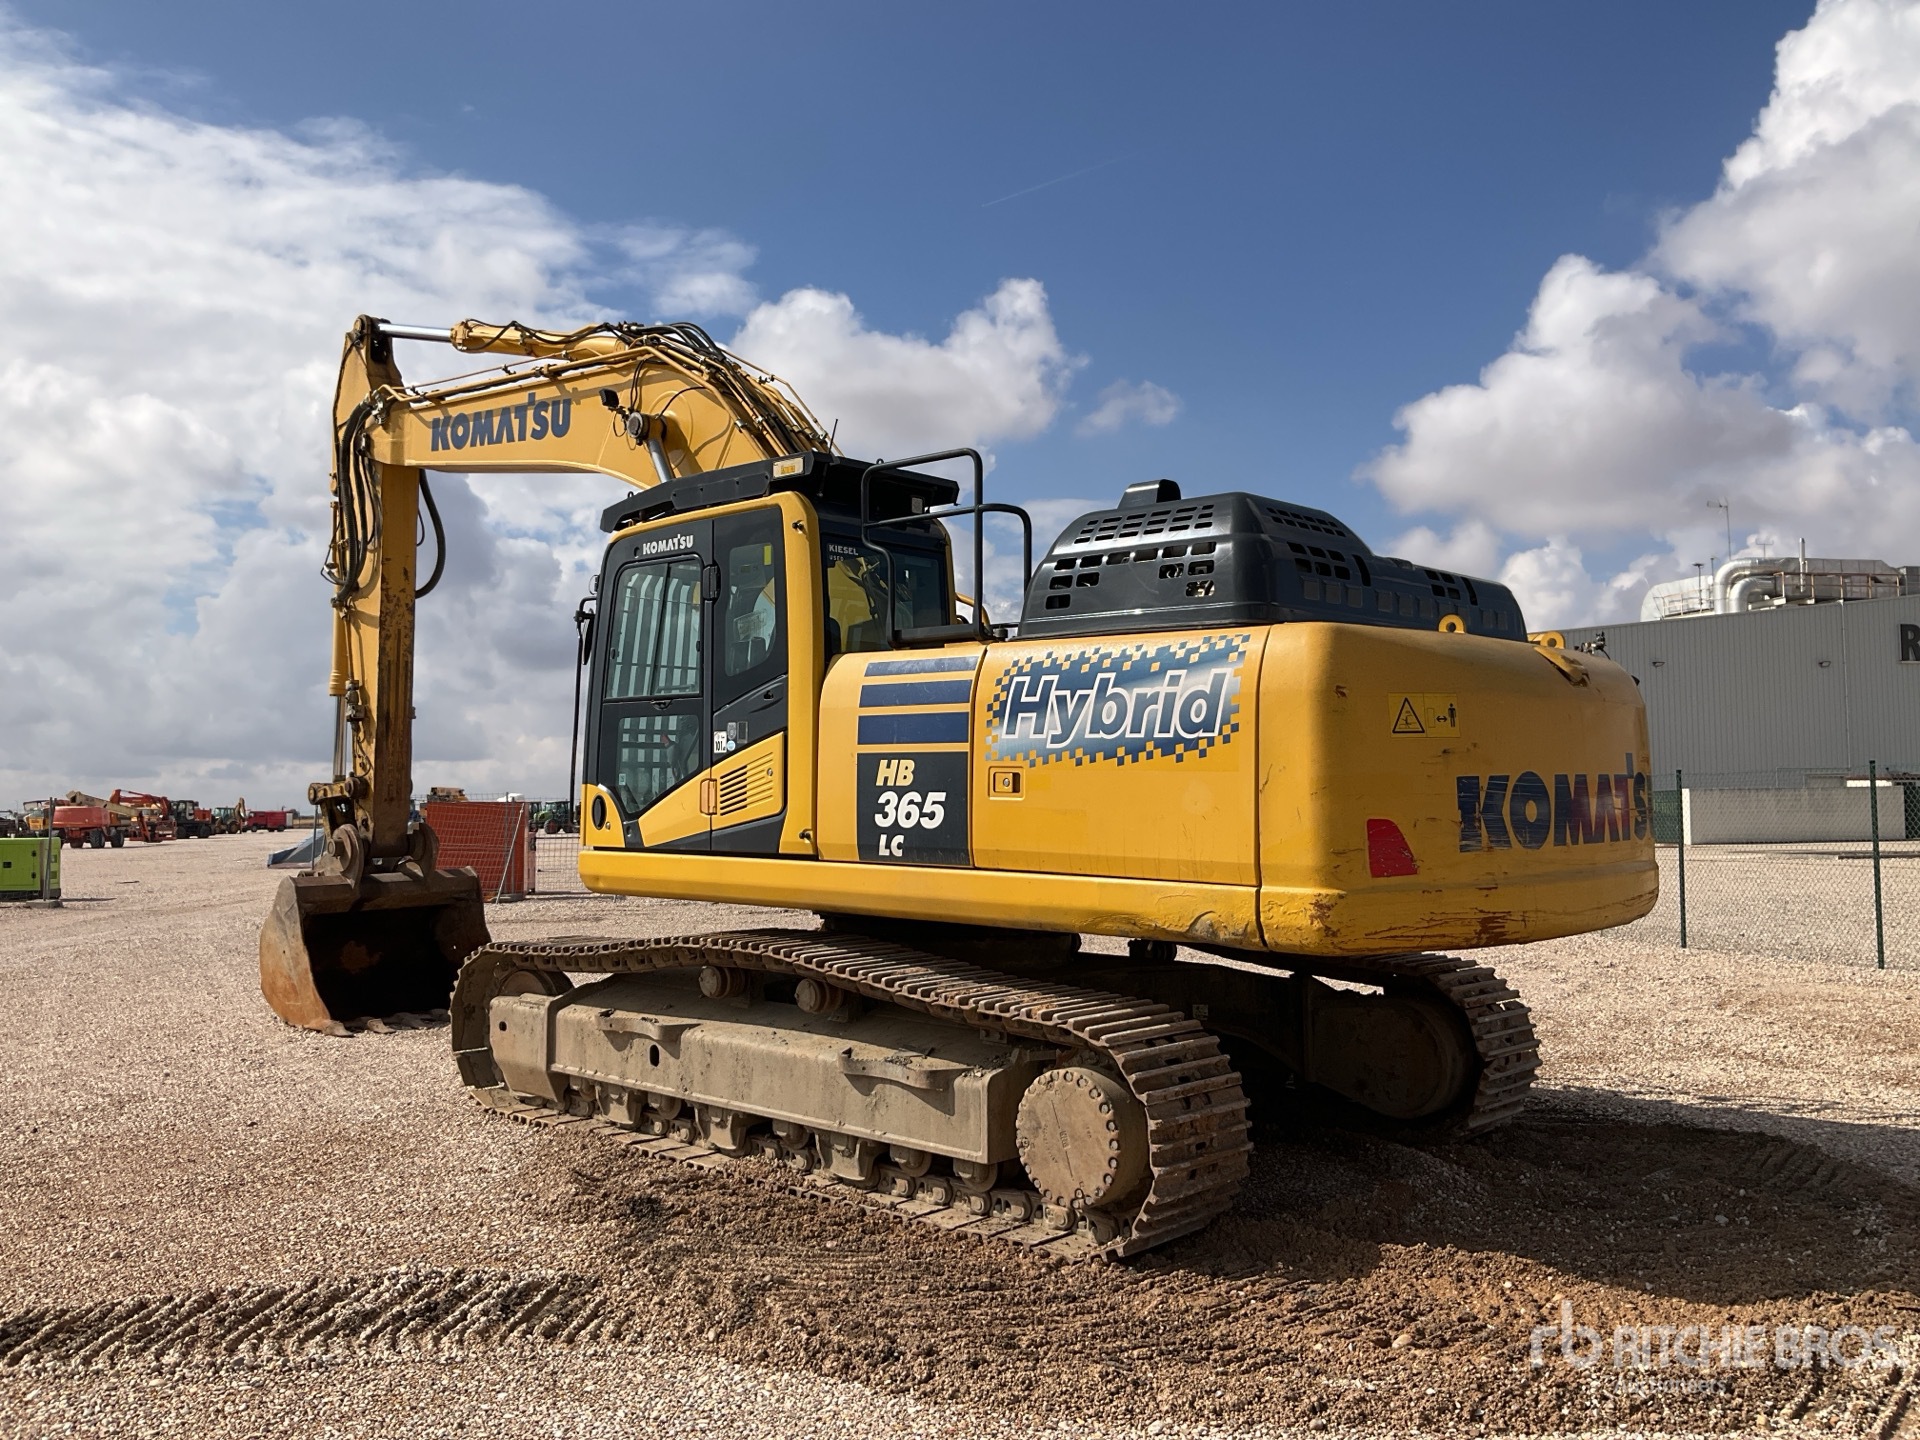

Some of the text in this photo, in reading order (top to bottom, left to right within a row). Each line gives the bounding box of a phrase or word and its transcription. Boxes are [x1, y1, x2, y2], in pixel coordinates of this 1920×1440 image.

[431, 392, 572, 452] KOMATSU
[643, 533, 694, 555] KOMATSU
[829, 544, 859, 556] KIESEL
[1001, 668, 1231, 749] Hybrid
[875, 759, 916, 787] HB
[874, 790, 947, 830] 365
[878, 833, 905, 857] LC
